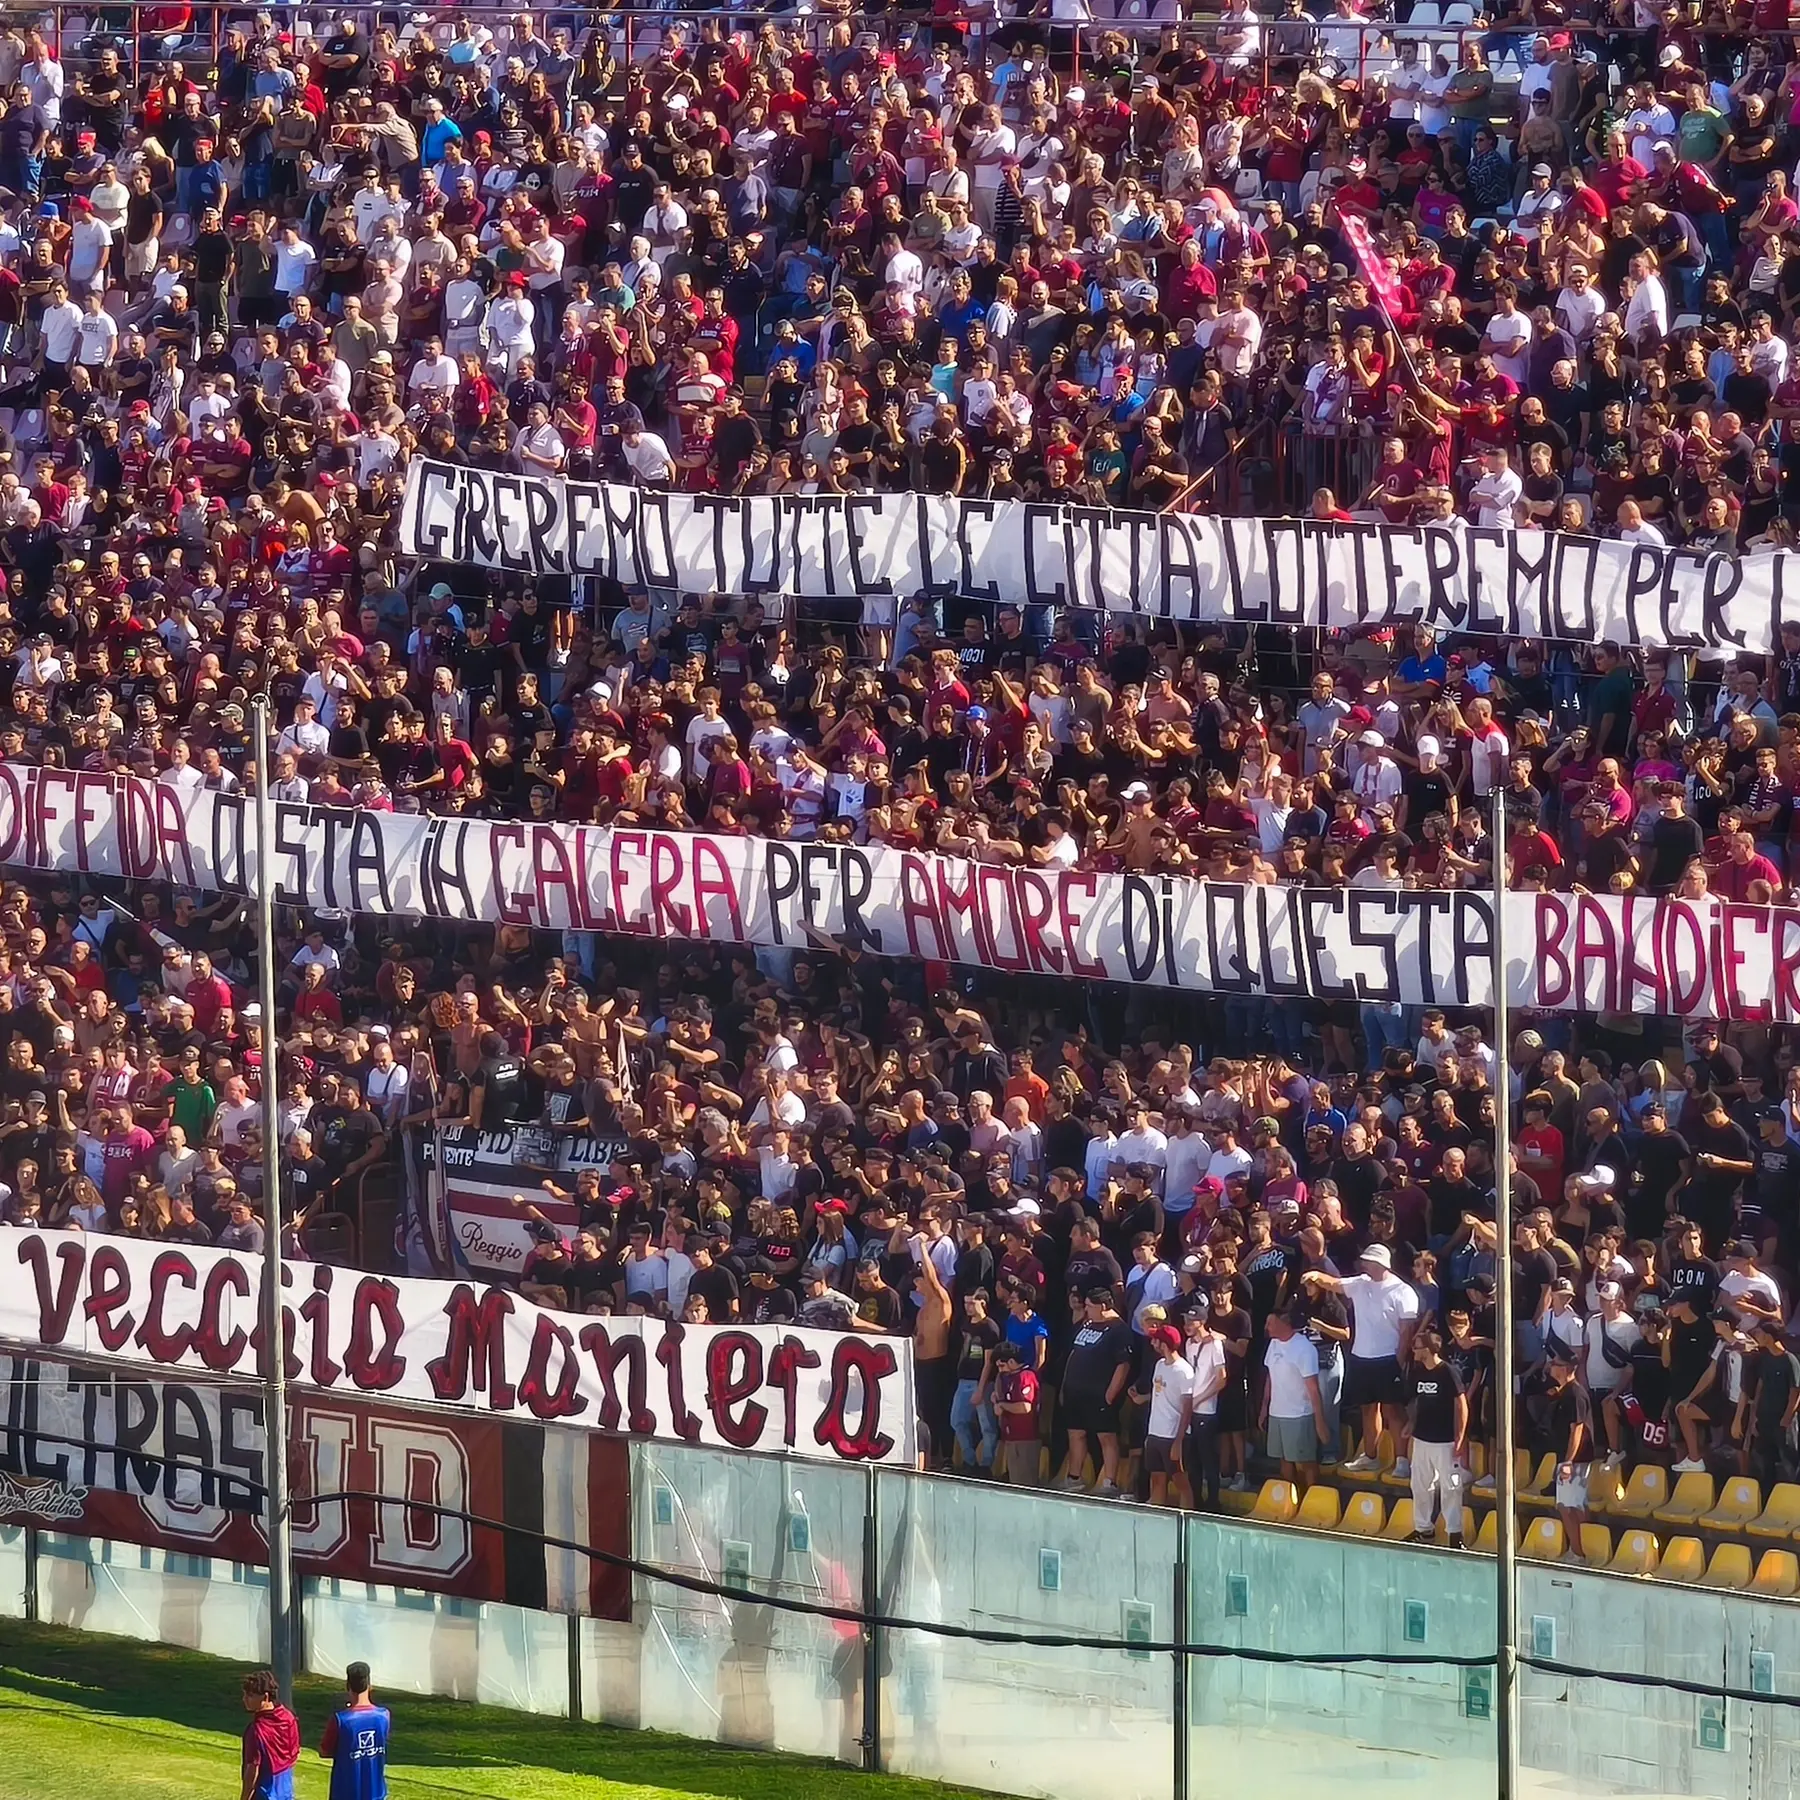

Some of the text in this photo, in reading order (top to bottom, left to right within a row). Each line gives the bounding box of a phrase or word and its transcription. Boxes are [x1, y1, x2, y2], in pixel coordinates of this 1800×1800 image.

[694, 492, 892, 596] TUTTE
[916, 495, 1000, 599] LE
[1221, 517, 1600, 640] LOTTEREMO
[1627, 543, 1747, 649] PER
[212, 792, 249, 896] O
[275, 802, 394, 912] STA
[489, 824, 745, 943] GALERA
[766, 842, 884, 951] PER
[901, 860, 1108, 978] AMORE
[1204, 884, 1496, 1006] QUESTA
[460, 1221, 523, 1263] Reggio
[1672, 1268, 1706, 1287] ICON
